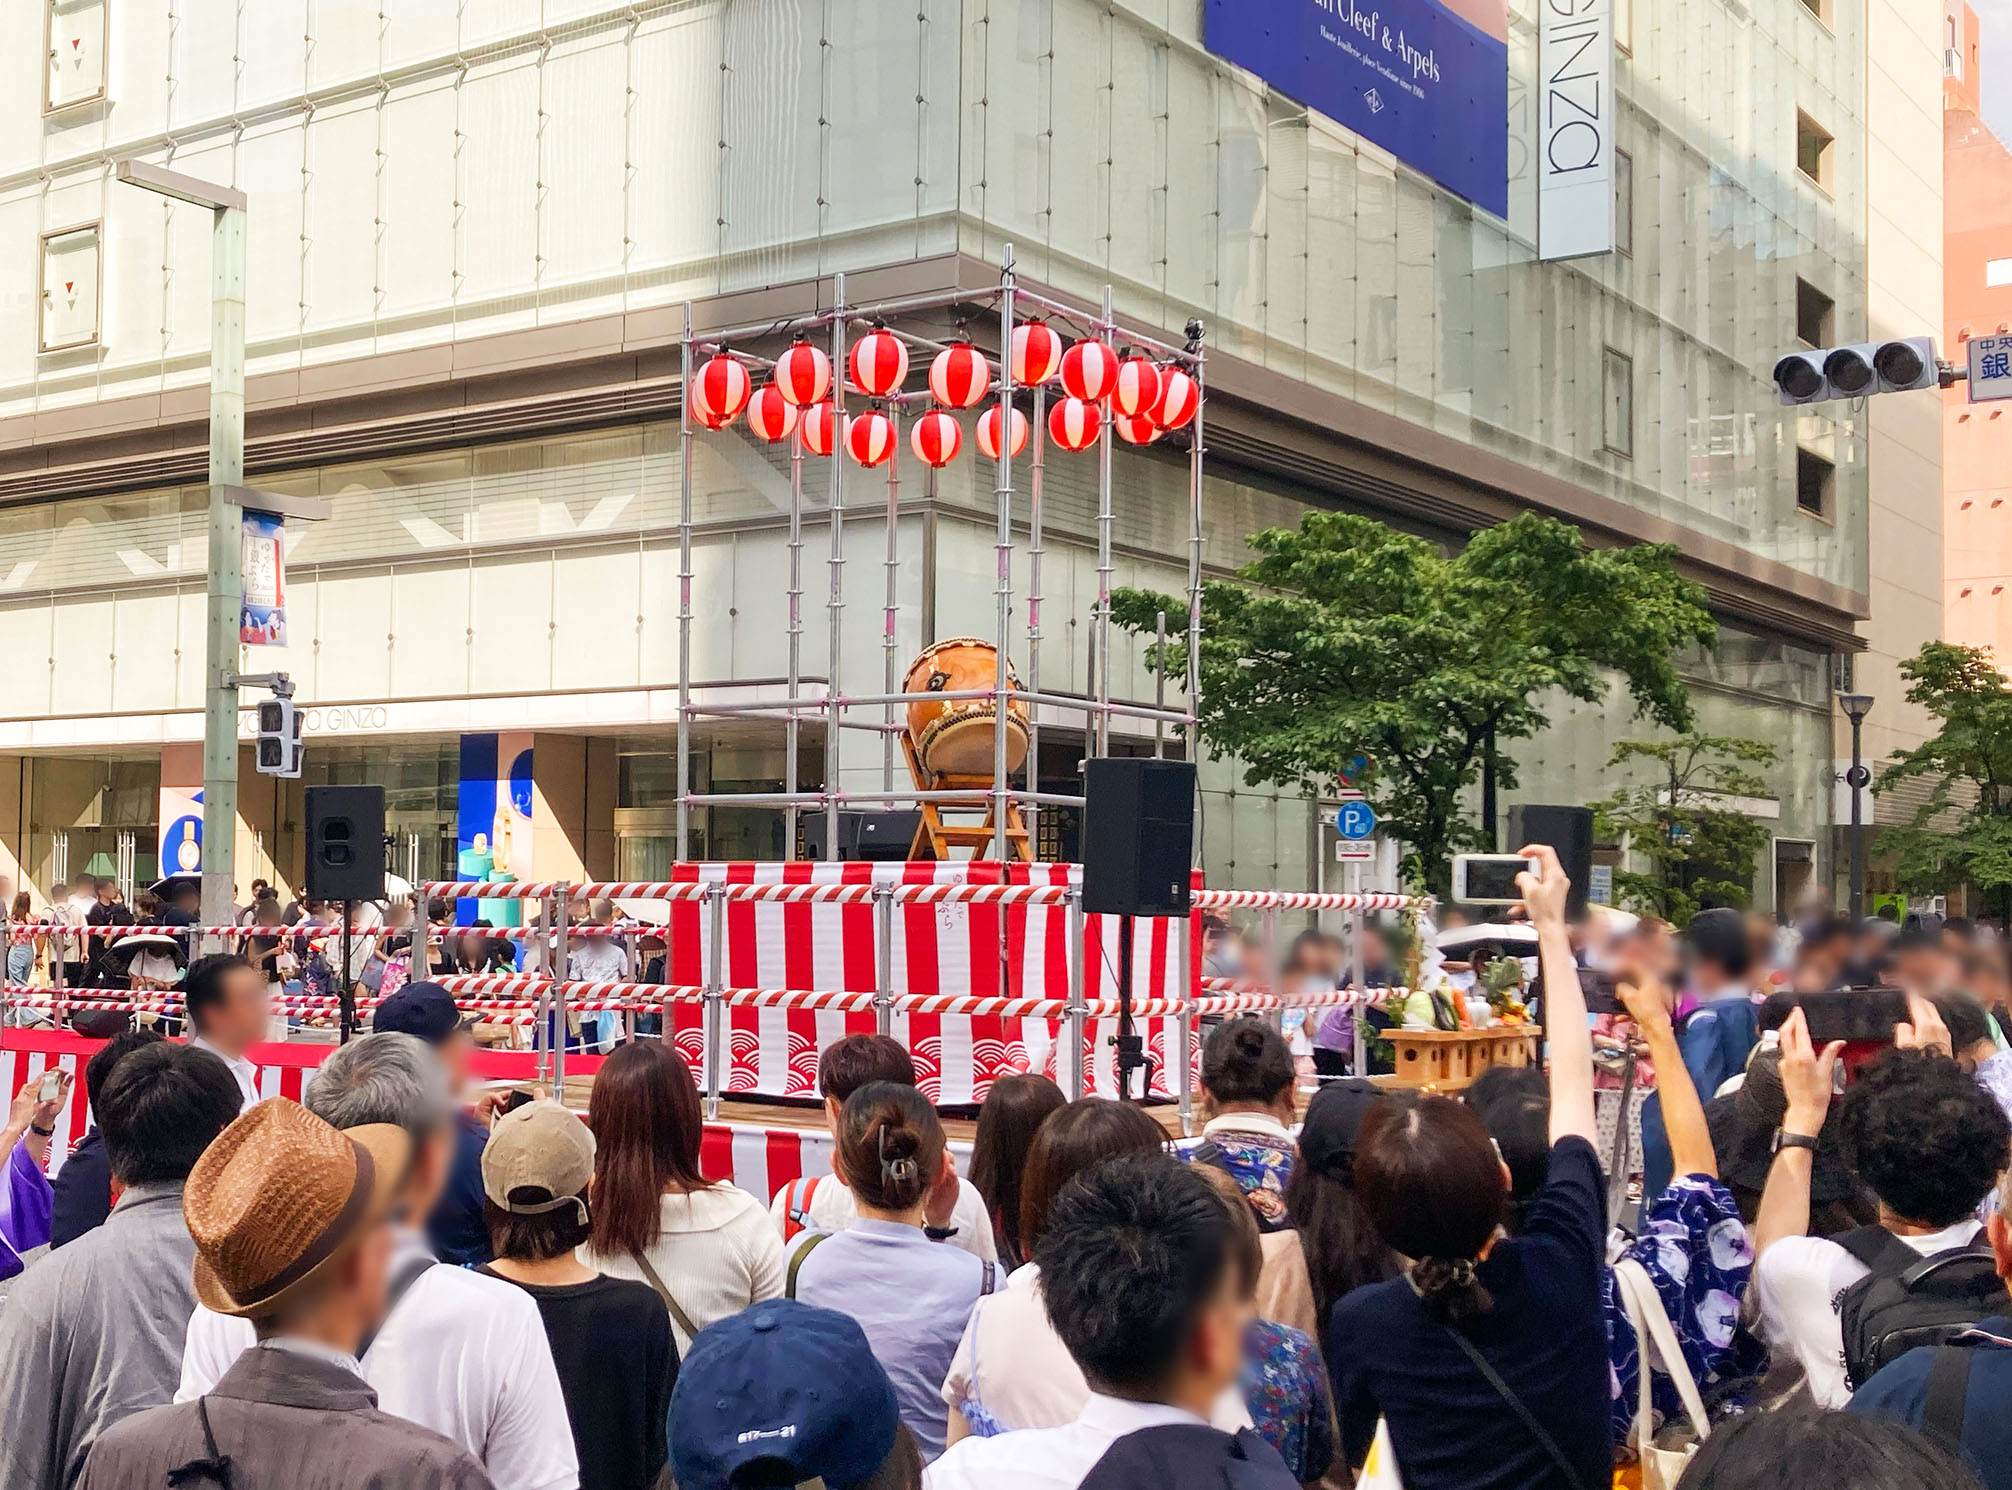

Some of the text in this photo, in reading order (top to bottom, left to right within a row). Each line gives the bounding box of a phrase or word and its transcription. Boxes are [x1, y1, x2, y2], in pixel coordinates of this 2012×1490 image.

[1337, 0, 1440, 83] Cleef & Arpels
[1981, 352, 2012, 380] 銀
[1345, 810, 1360, 834] P
